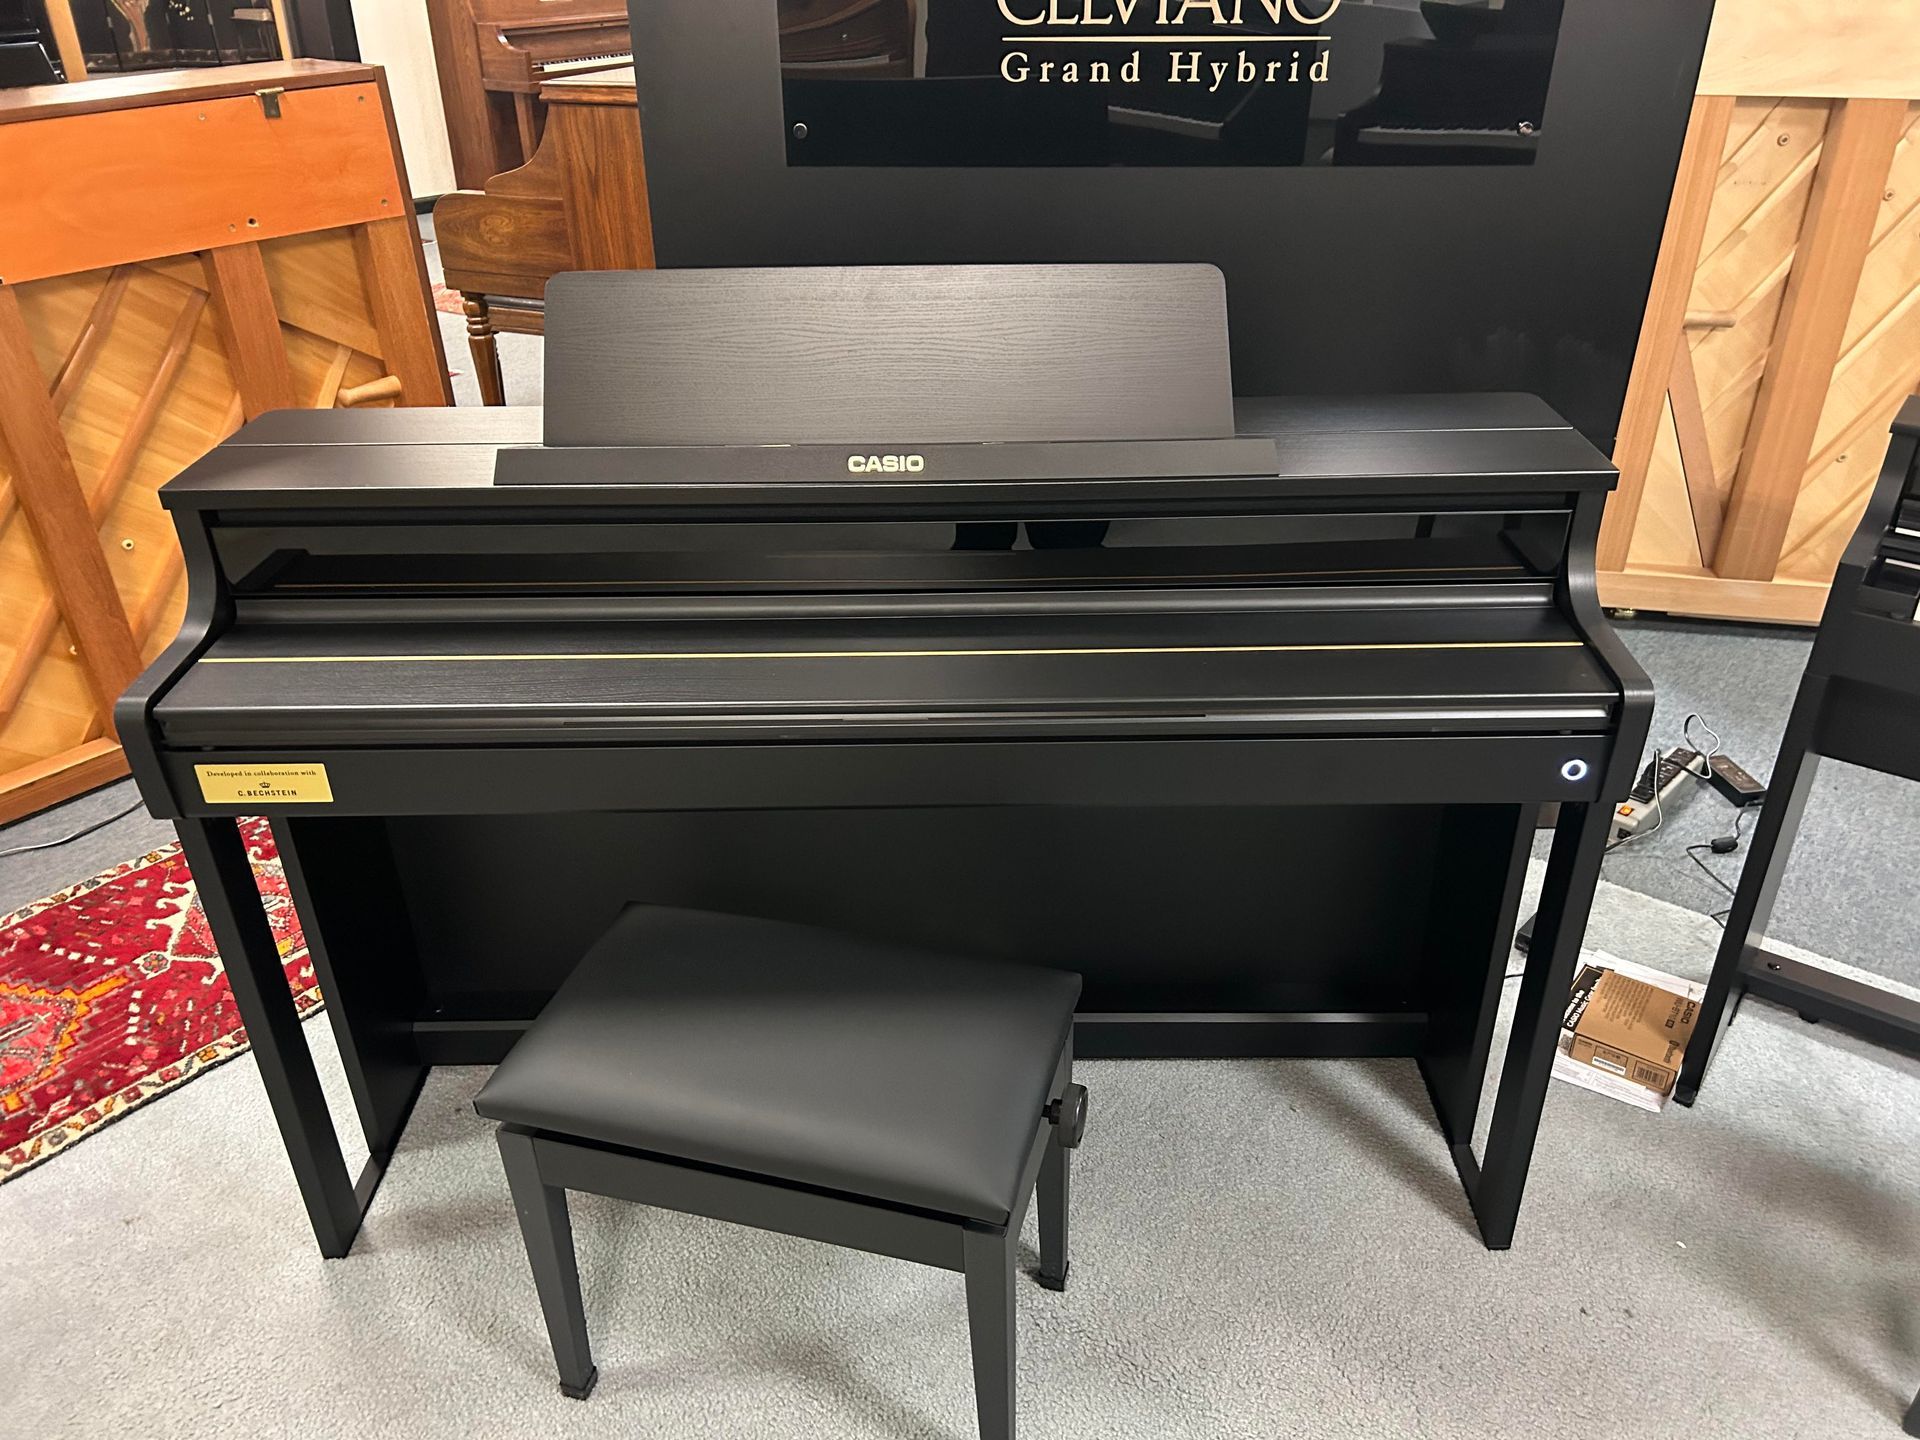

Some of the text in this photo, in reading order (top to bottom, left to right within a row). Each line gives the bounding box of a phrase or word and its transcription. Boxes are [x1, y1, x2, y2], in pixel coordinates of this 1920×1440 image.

[1000, 50, 1331, 92] Grand Hybrid
[847, 455, 925, 473] CASIO
[206, 770, 242, 778] Developed
